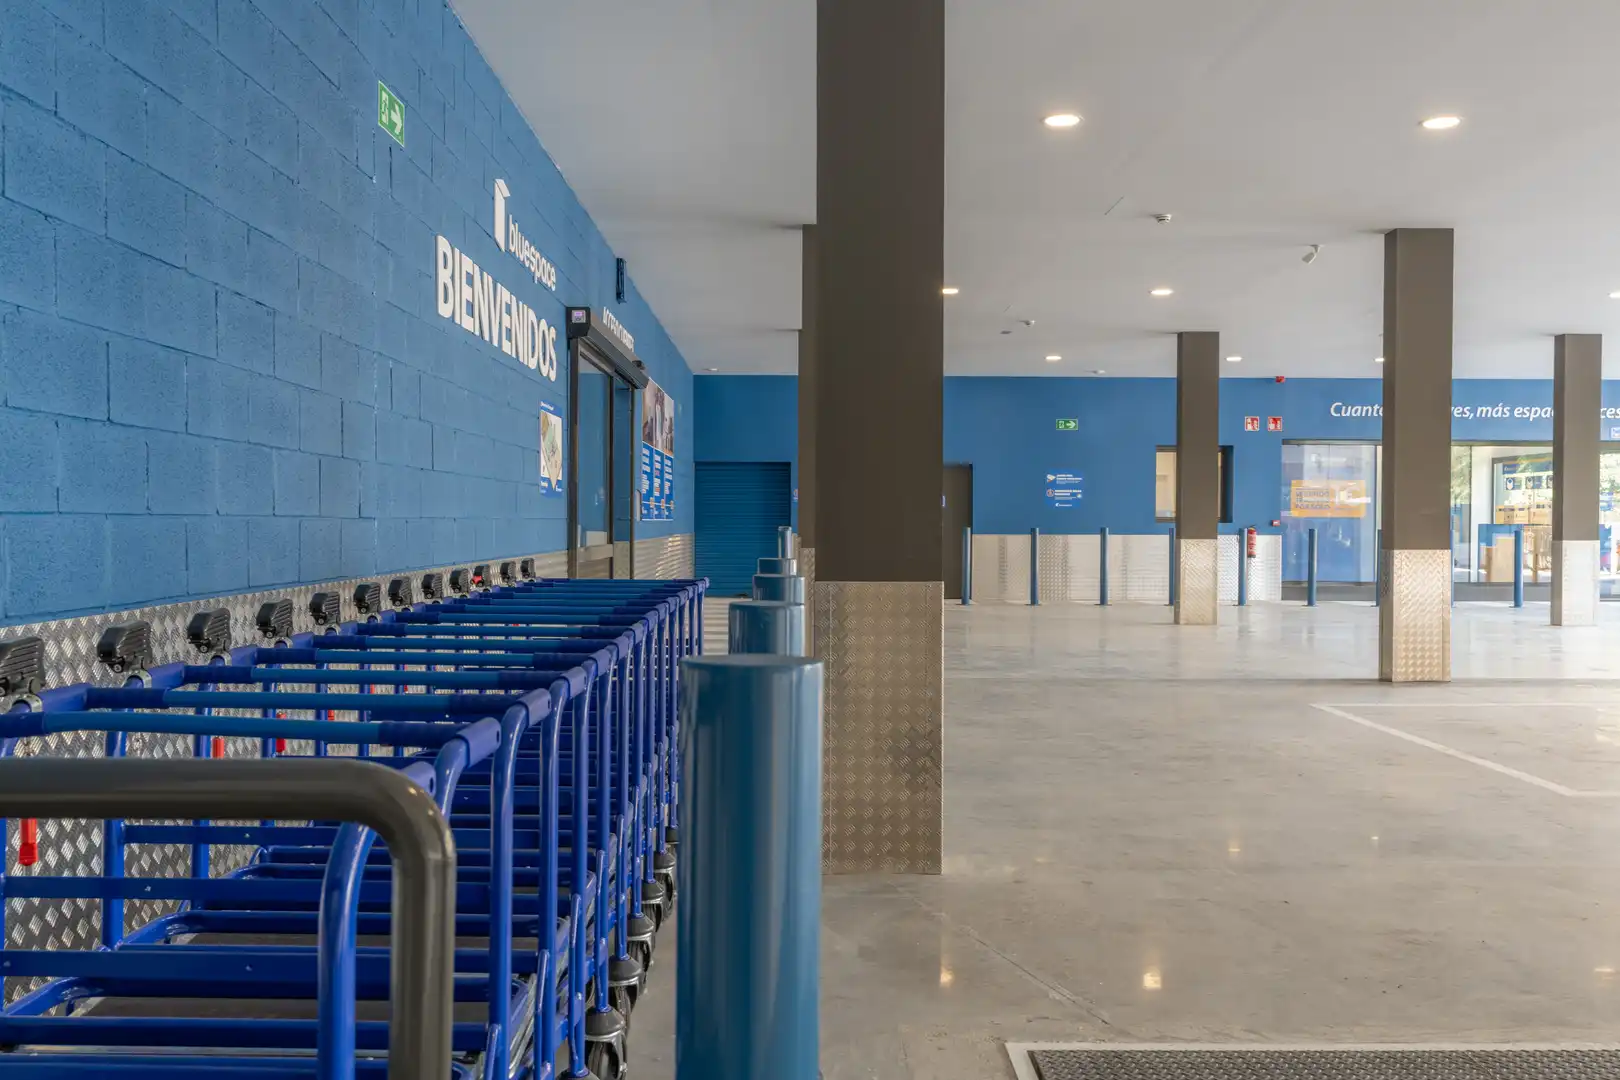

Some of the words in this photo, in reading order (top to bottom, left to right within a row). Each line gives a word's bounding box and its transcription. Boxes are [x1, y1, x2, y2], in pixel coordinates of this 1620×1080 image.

[508, 214, 556, 291] bluespace
[436, 234, 557, 382] BIENVENIDOS
[1451, 406, 1474, 420] es,
[1476, 402, 1510, 418] más
